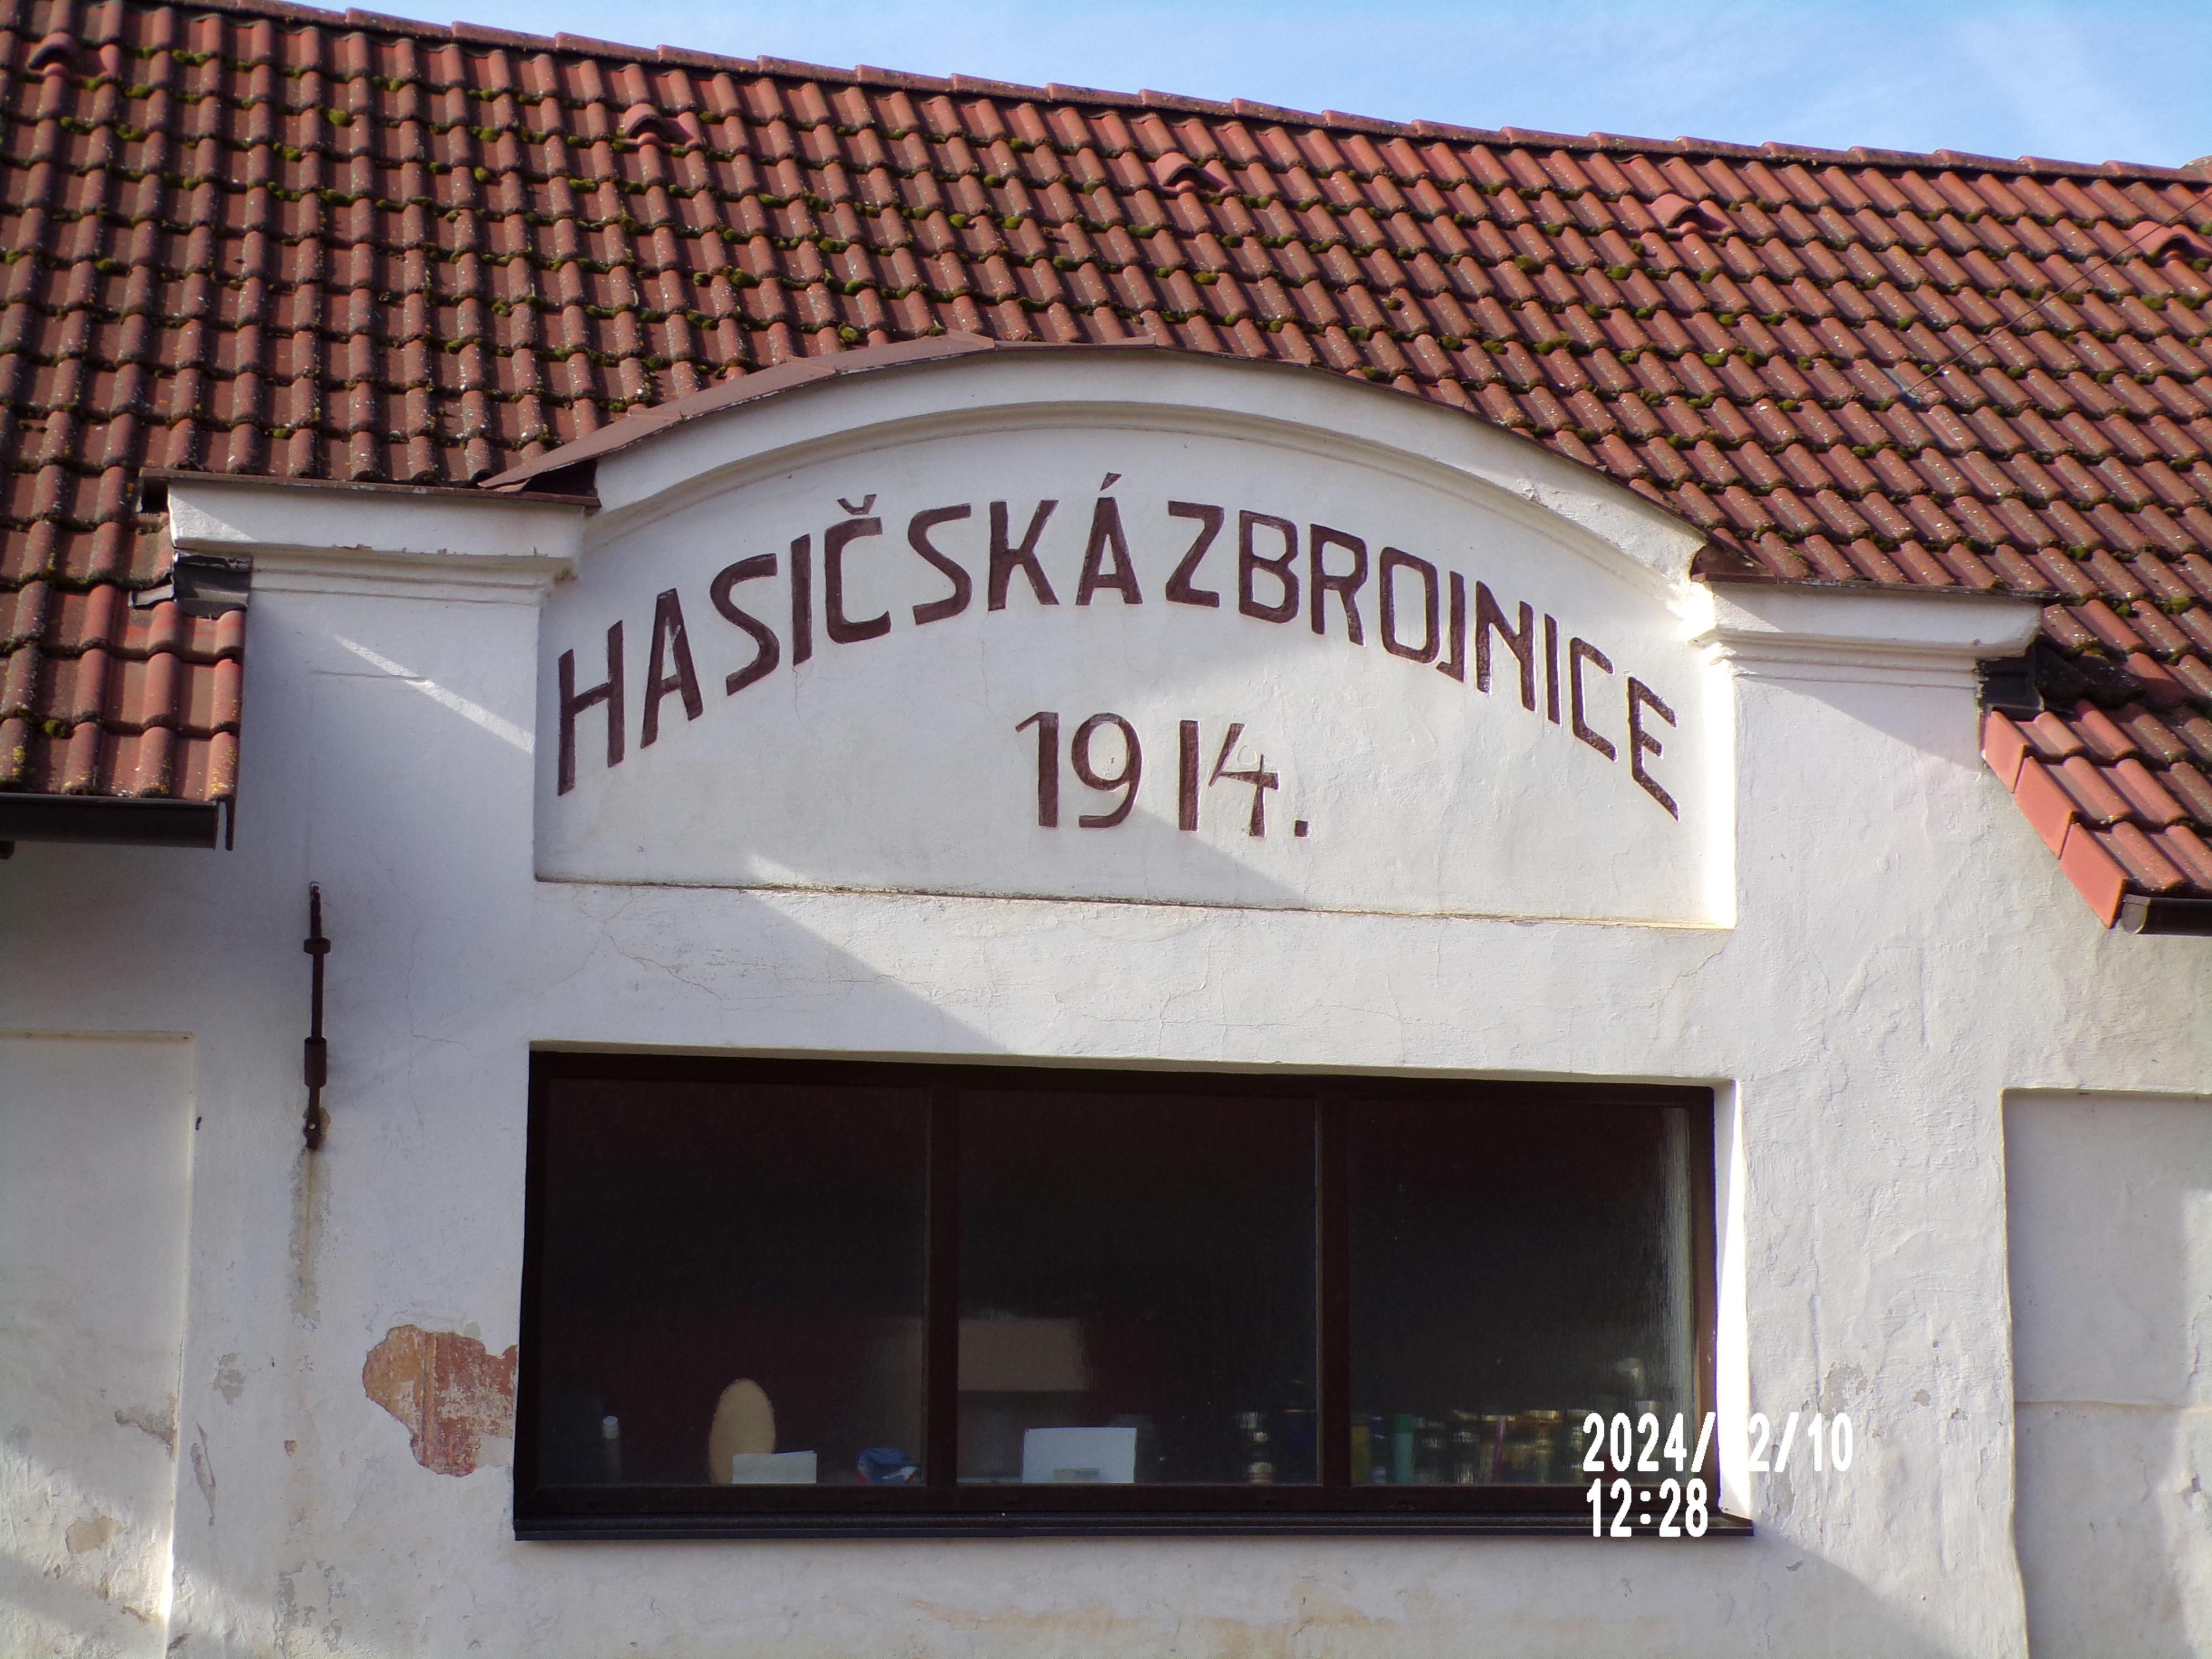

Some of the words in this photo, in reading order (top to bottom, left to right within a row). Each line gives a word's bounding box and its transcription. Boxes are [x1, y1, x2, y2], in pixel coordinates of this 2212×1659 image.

[558, 472, 1142, 795] HASIČSKÁ
[1165, 500, 1678, 821] ZBROJNICE
[1015, 711, 1308, 838] 1914.
